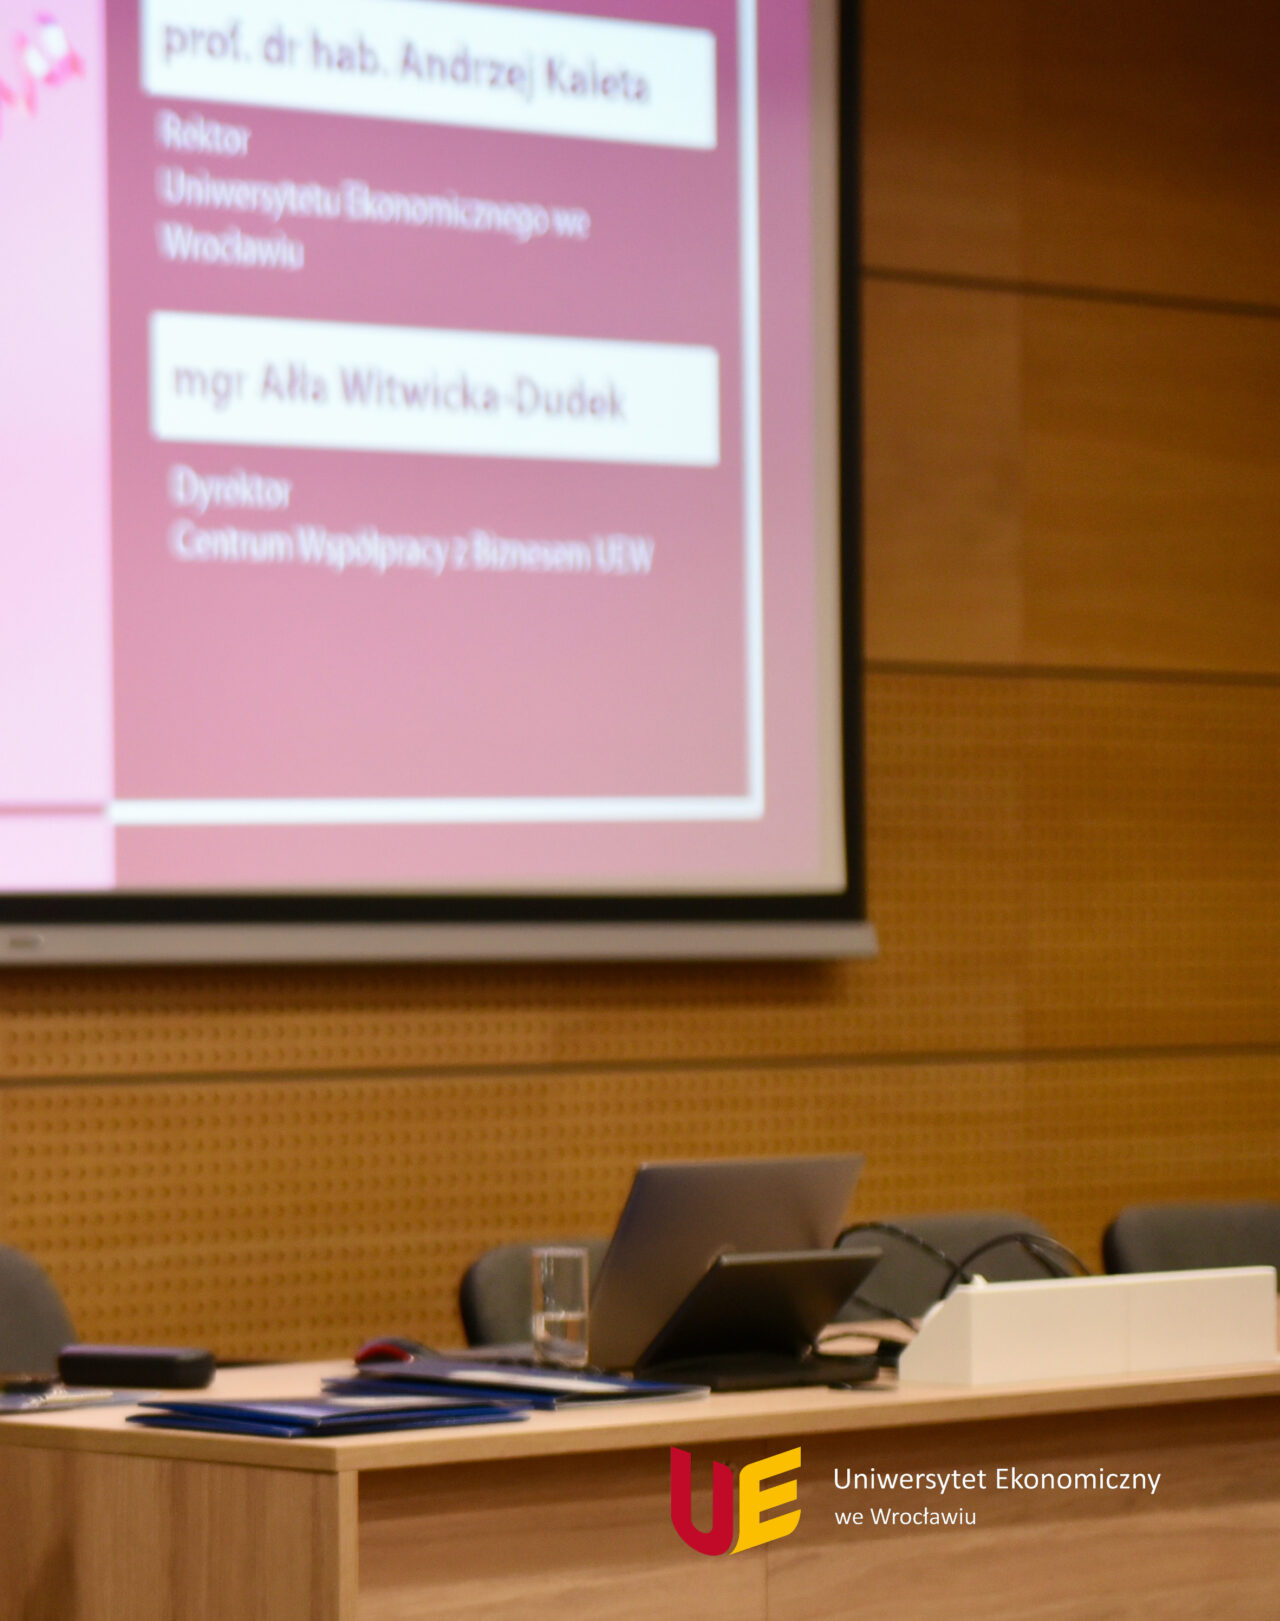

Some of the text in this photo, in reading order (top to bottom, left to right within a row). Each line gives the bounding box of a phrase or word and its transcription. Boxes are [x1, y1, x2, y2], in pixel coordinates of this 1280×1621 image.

[163, 17, 252, 68] prof.
[262, 23, 300, 66] dr
[311, 24, 389, 77] hab.
[401, 42, 537, 101] Andrzej
[159, 110, 251, 157] Rektor
[159, 167, 591, 242] Uniwersytetu Ekonomicznego we
[160, 223, 305, 271] Wrocławiu
[172, 362, 246, 413] mgr
[337, 364, 629, 423] Witwicka-Dudek
[172, 463, 292, 515] Dyrektor
[172, 519, 658, 576] Centrum Współpracy z Biznesem UEW
